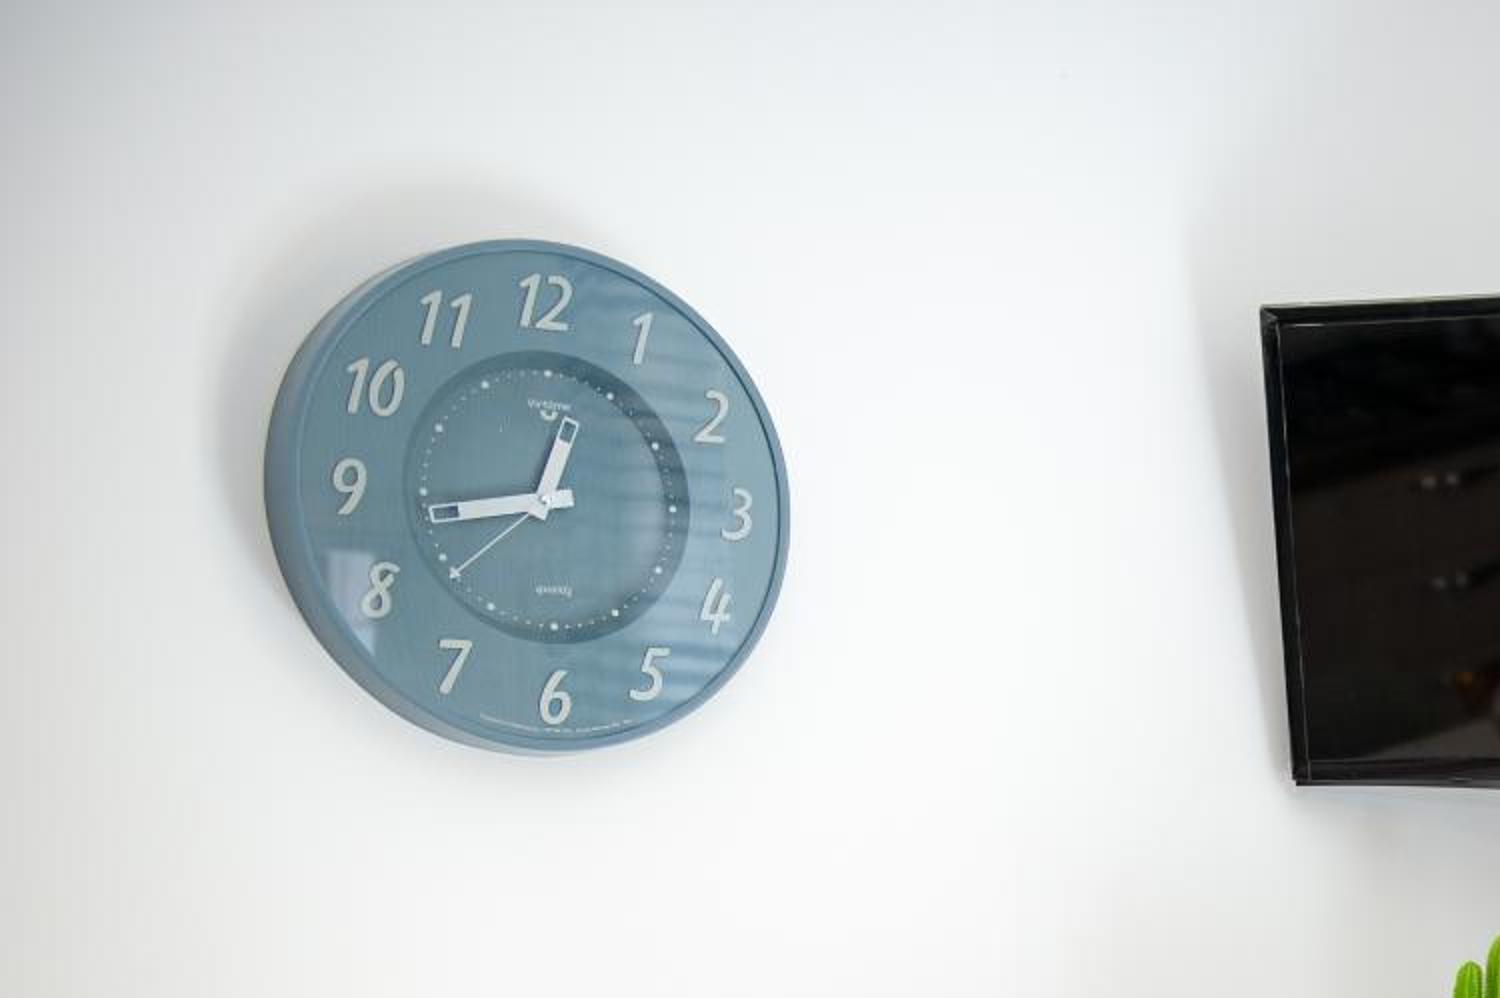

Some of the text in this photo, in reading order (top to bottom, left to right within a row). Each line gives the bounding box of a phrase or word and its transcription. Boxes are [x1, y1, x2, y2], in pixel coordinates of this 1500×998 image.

[419, 289, 473, 348] 11
[518, 273, 574, 331] 12
[631, 312, 654, 365] 1
[345, 356, 405, 416] 10
[693, 389, 730, 443] 2
[331, 457, 368, 515] 9
[720, 488, 753, 542] 3
[360, 560, 401, 619] 8
[699, 576, 732, 635] 4
[438, 639, 473, 694] 7
[628, 646, 671, 701] 5
[538, 669, 572, 726] 6
